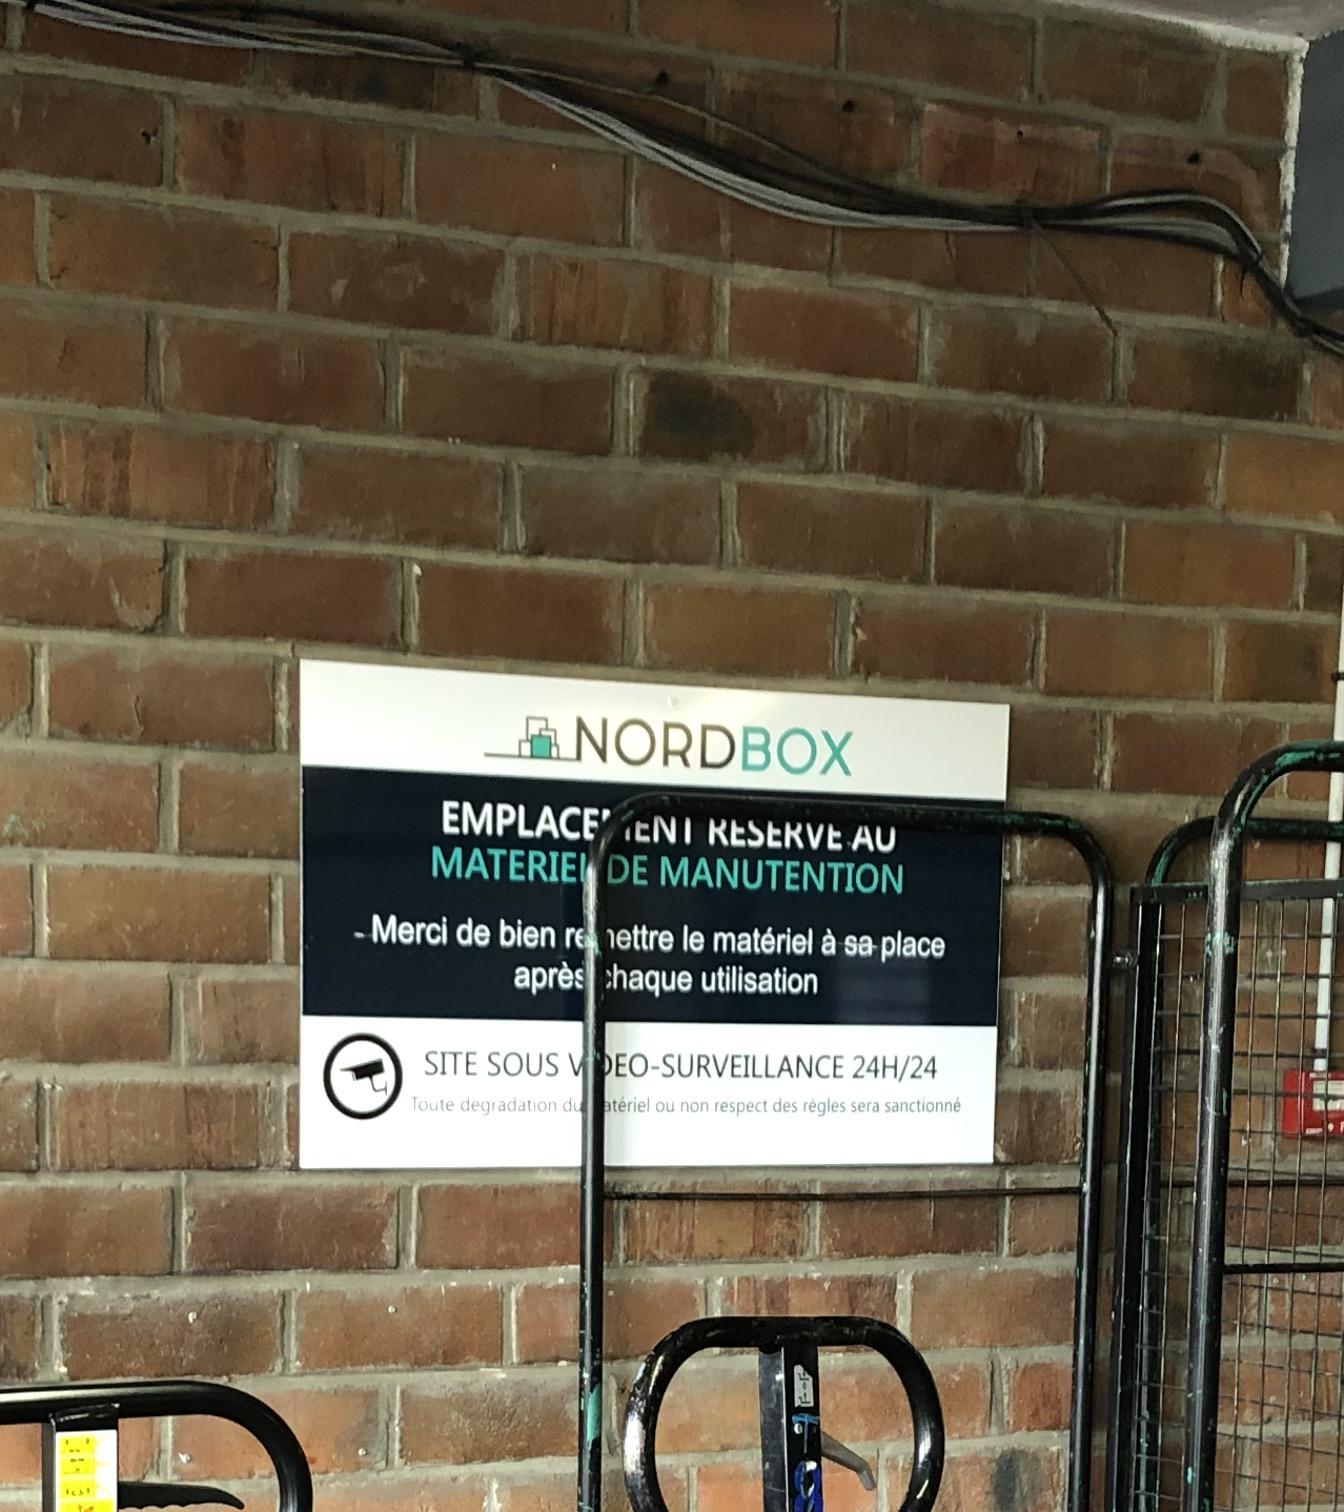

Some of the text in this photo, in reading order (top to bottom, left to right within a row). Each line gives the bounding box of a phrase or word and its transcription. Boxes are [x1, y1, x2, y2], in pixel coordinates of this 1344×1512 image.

[575, 714, 854, 777] NORDBOX
[441, 799, 692, 846] EMPLACEENT
[851, 825, 897, 853] AU
[607, 853, 649, 886] DE
[659, 855, 904, 895] MANUTENTION
[370, 913, 448, 945] Merci
[455, 916, 491, 947] de
[499, 918, 556, 949] bien
[682, 924, 705, 952] le
[712, 926, 813, 957] matériel
[820, 928, 837, 957] à
[843, 935, 873, 957] sa
[881, 929, 946, 964] place
[513, 961, 584, 996] après
[701, 965, 818, 995] utilisation
[424, 1050, 478, 1077] SITE
[487, 1051, 559, 1078] SOUS
[851, 1054, 938, 1083] 24H/24
[411, 1096, 455, 1113] Toute
[563, 1097, 583, 1113] du
[604, 1096, 651, 1114] atériel
[656, 1101, 676, 1113] ou
[680, 1101, 709, 1113] non
[714, 1098, 768, 1117] respect
[772, 1097, 798, 1113] des
[803, 1097, 846, 1117] règles
[851, 1101, 880, 1113] sera
[884, 1096, 962, 1114] sanctionné
